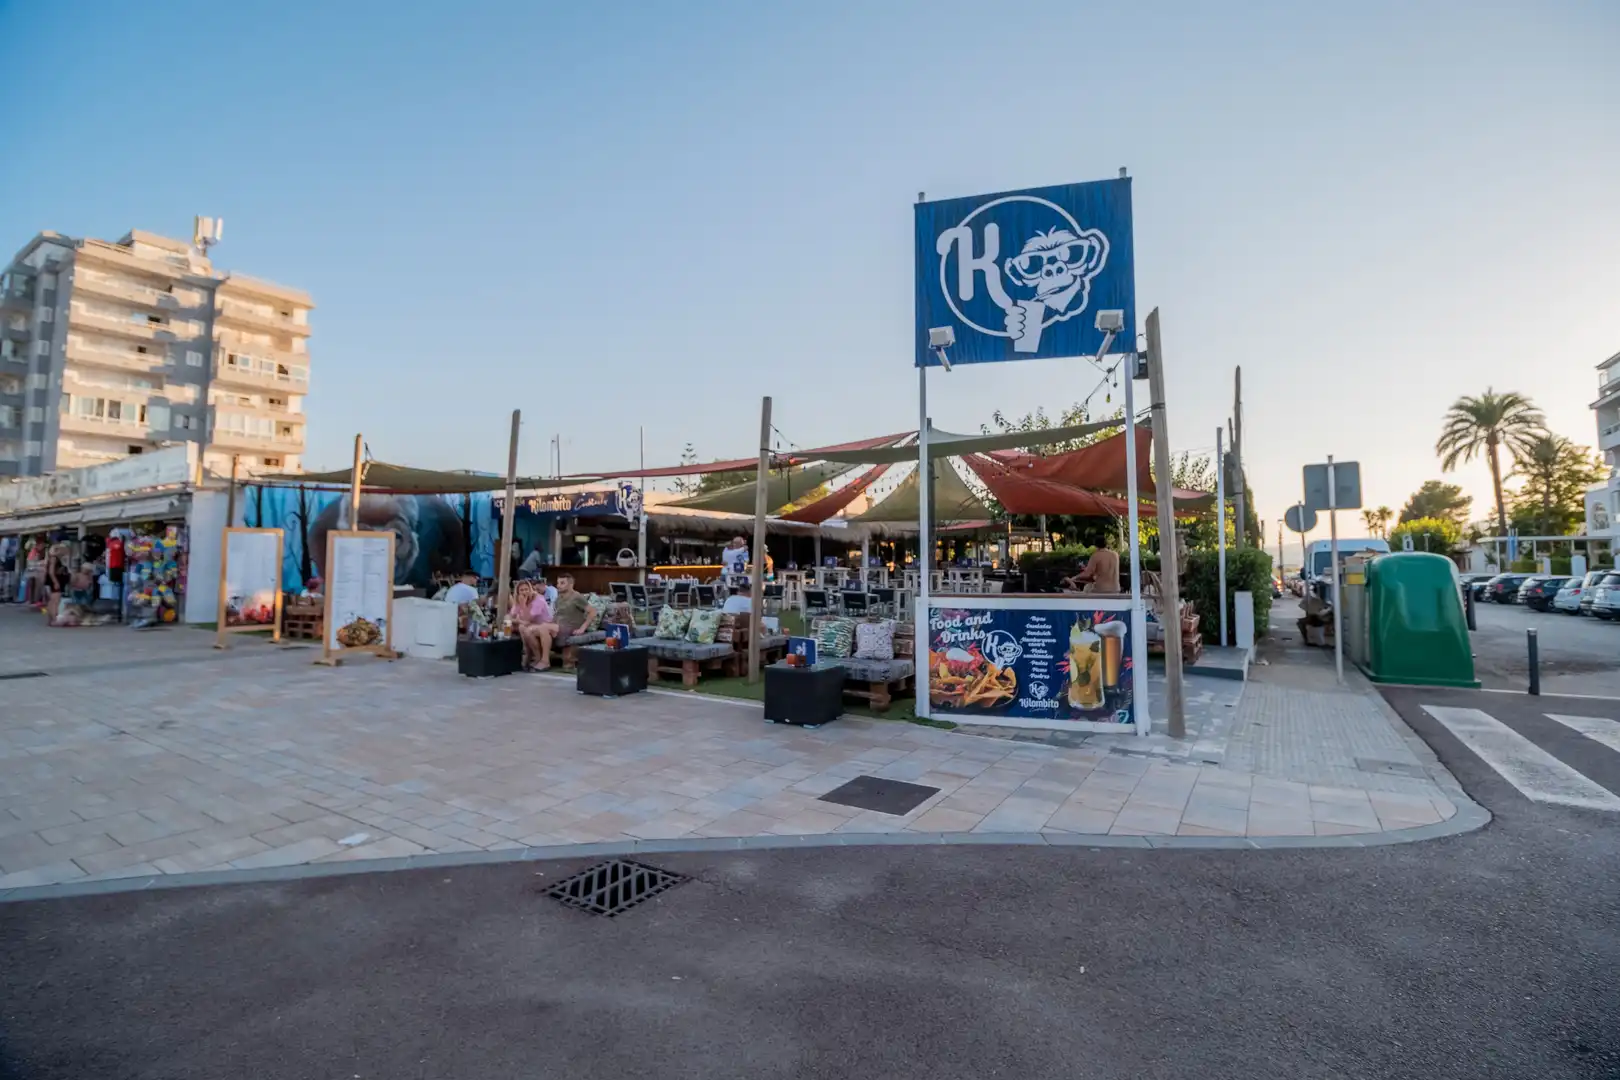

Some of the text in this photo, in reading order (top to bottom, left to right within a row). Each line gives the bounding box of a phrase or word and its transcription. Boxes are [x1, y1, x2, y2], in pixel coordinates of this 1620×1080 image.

[528, 495, 572, 515] Kilombito
[930, 611, 994, 630] Food and
[940, 628, 986, 643] Drinks
[1019, 697, 1059, 708] Kilombito
